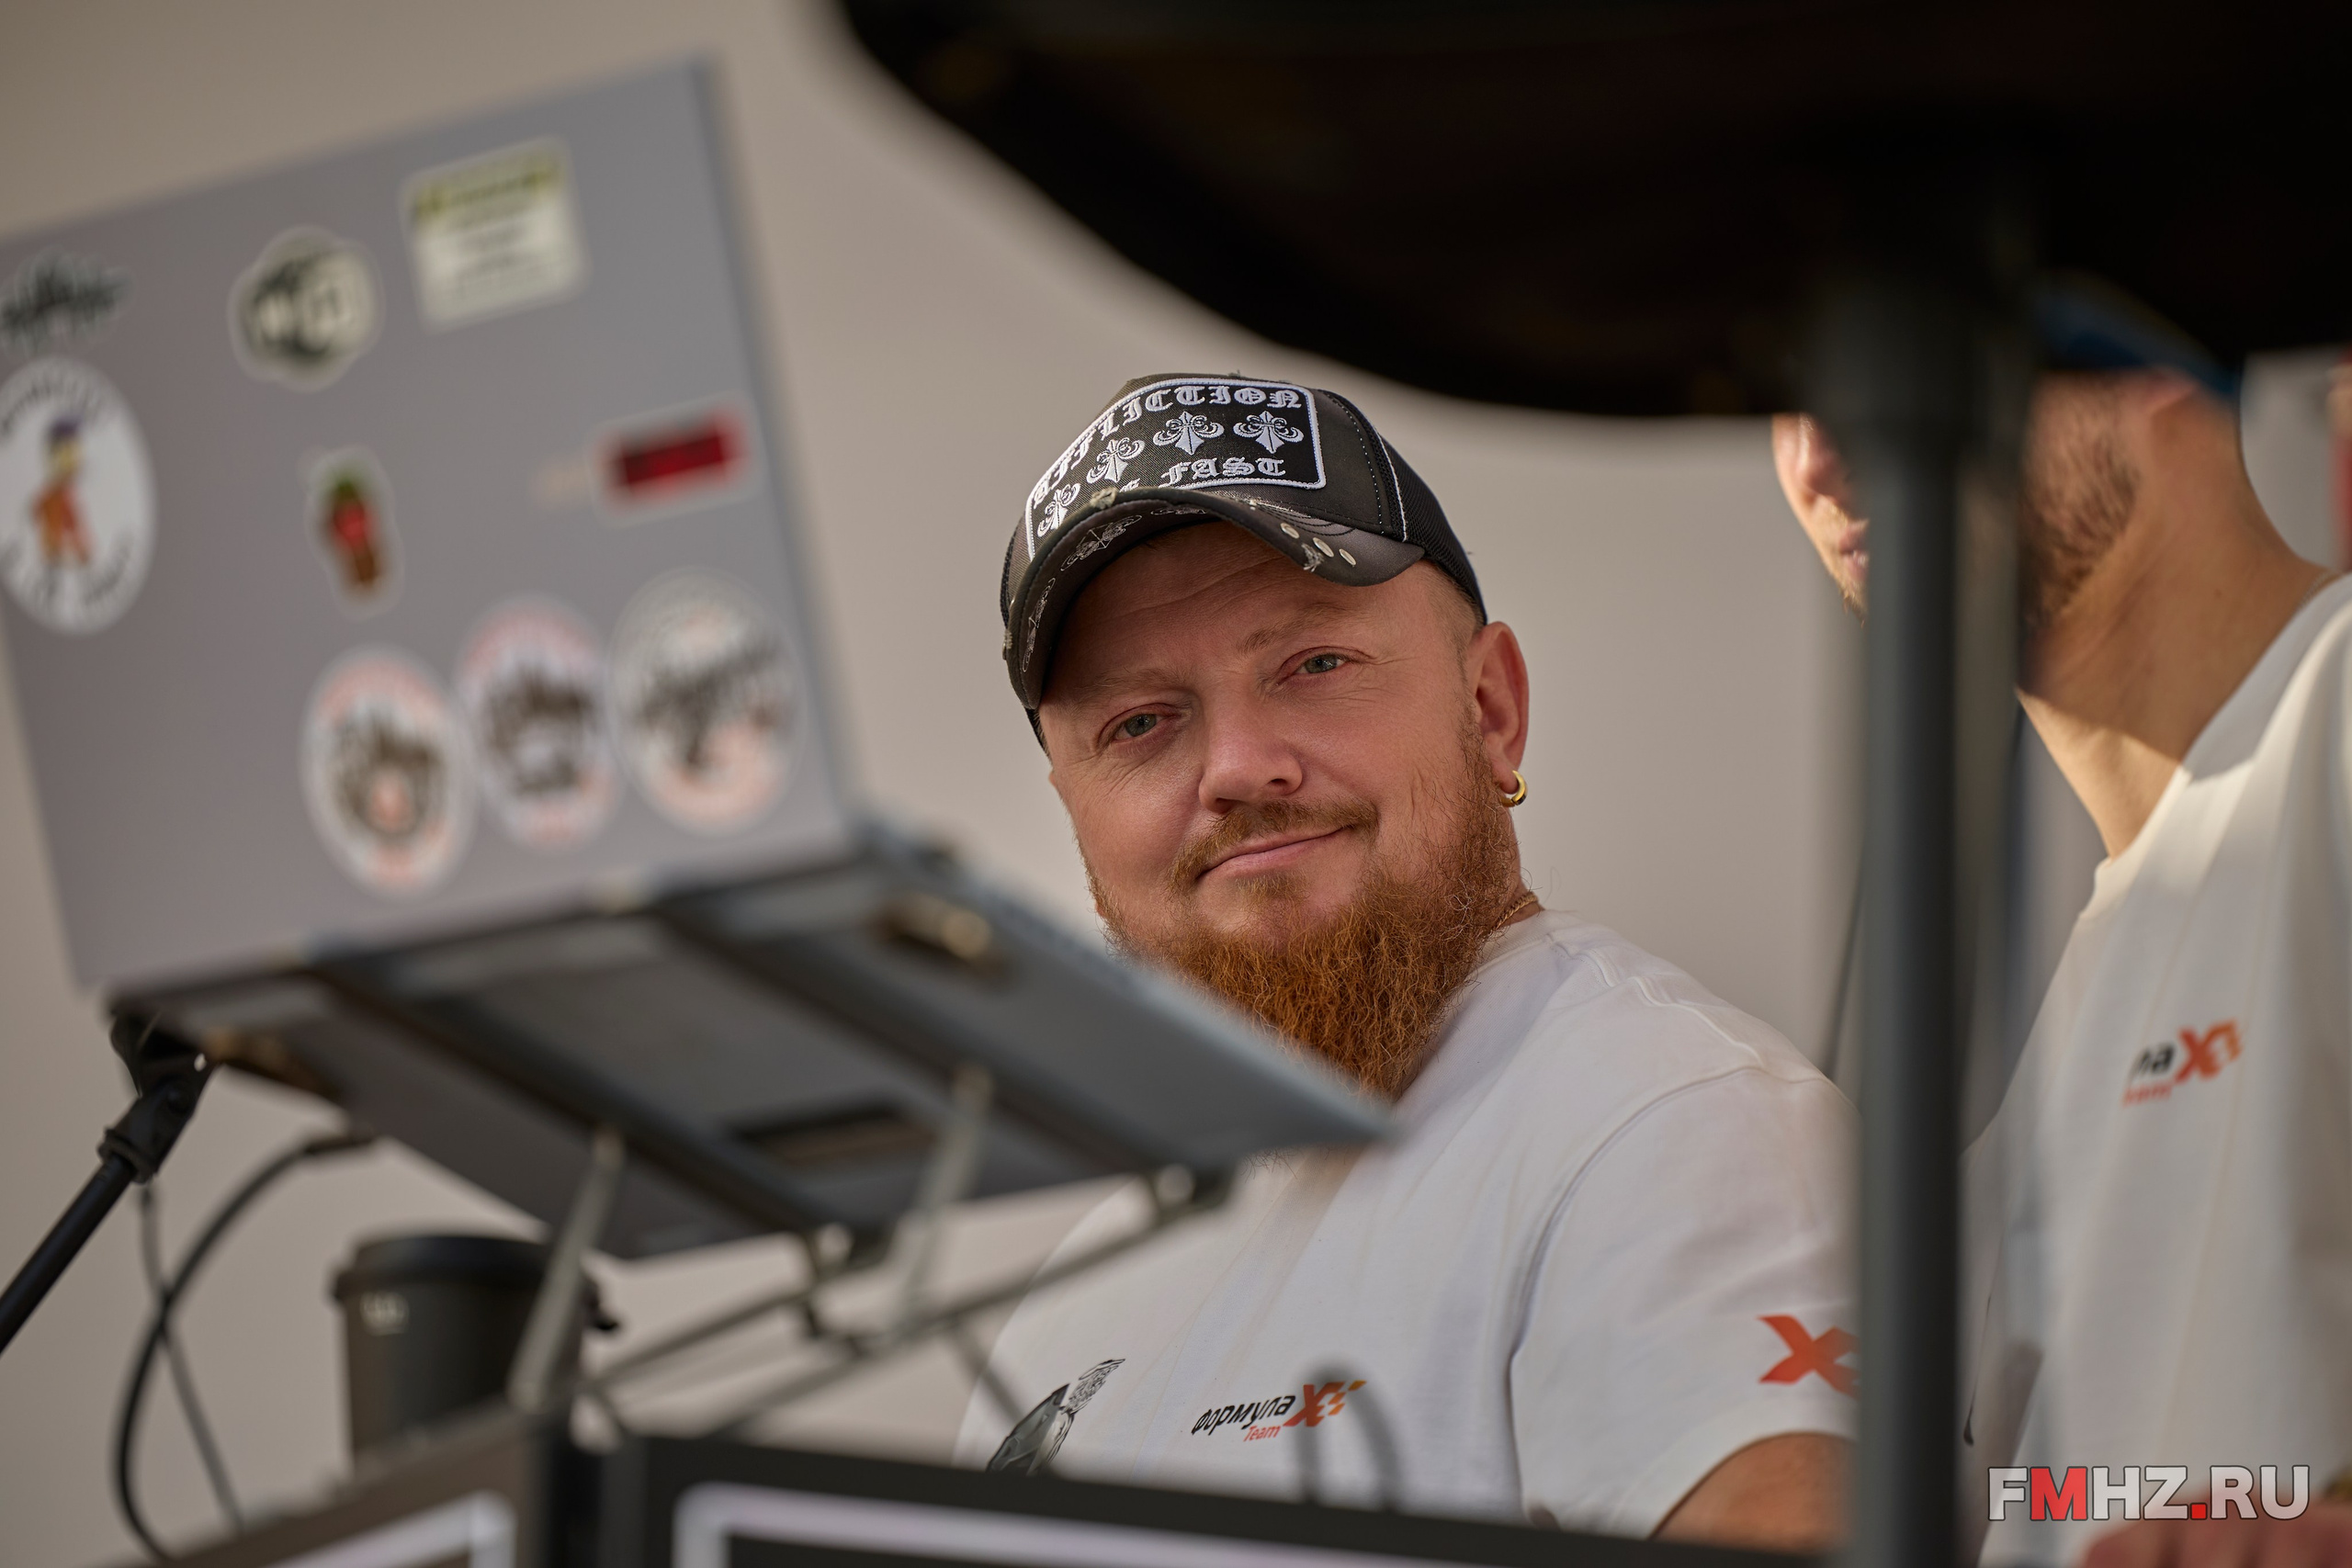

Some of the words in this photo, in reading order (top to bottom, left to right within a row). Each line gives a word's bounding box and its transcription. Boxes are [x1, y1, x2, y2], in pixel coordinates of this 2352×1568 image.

[1033, 386, 1302, 509] AFFLICTION
[1159, 457, 1286, 489] FAST
[1243, 1425, 1281, 1442] Team
